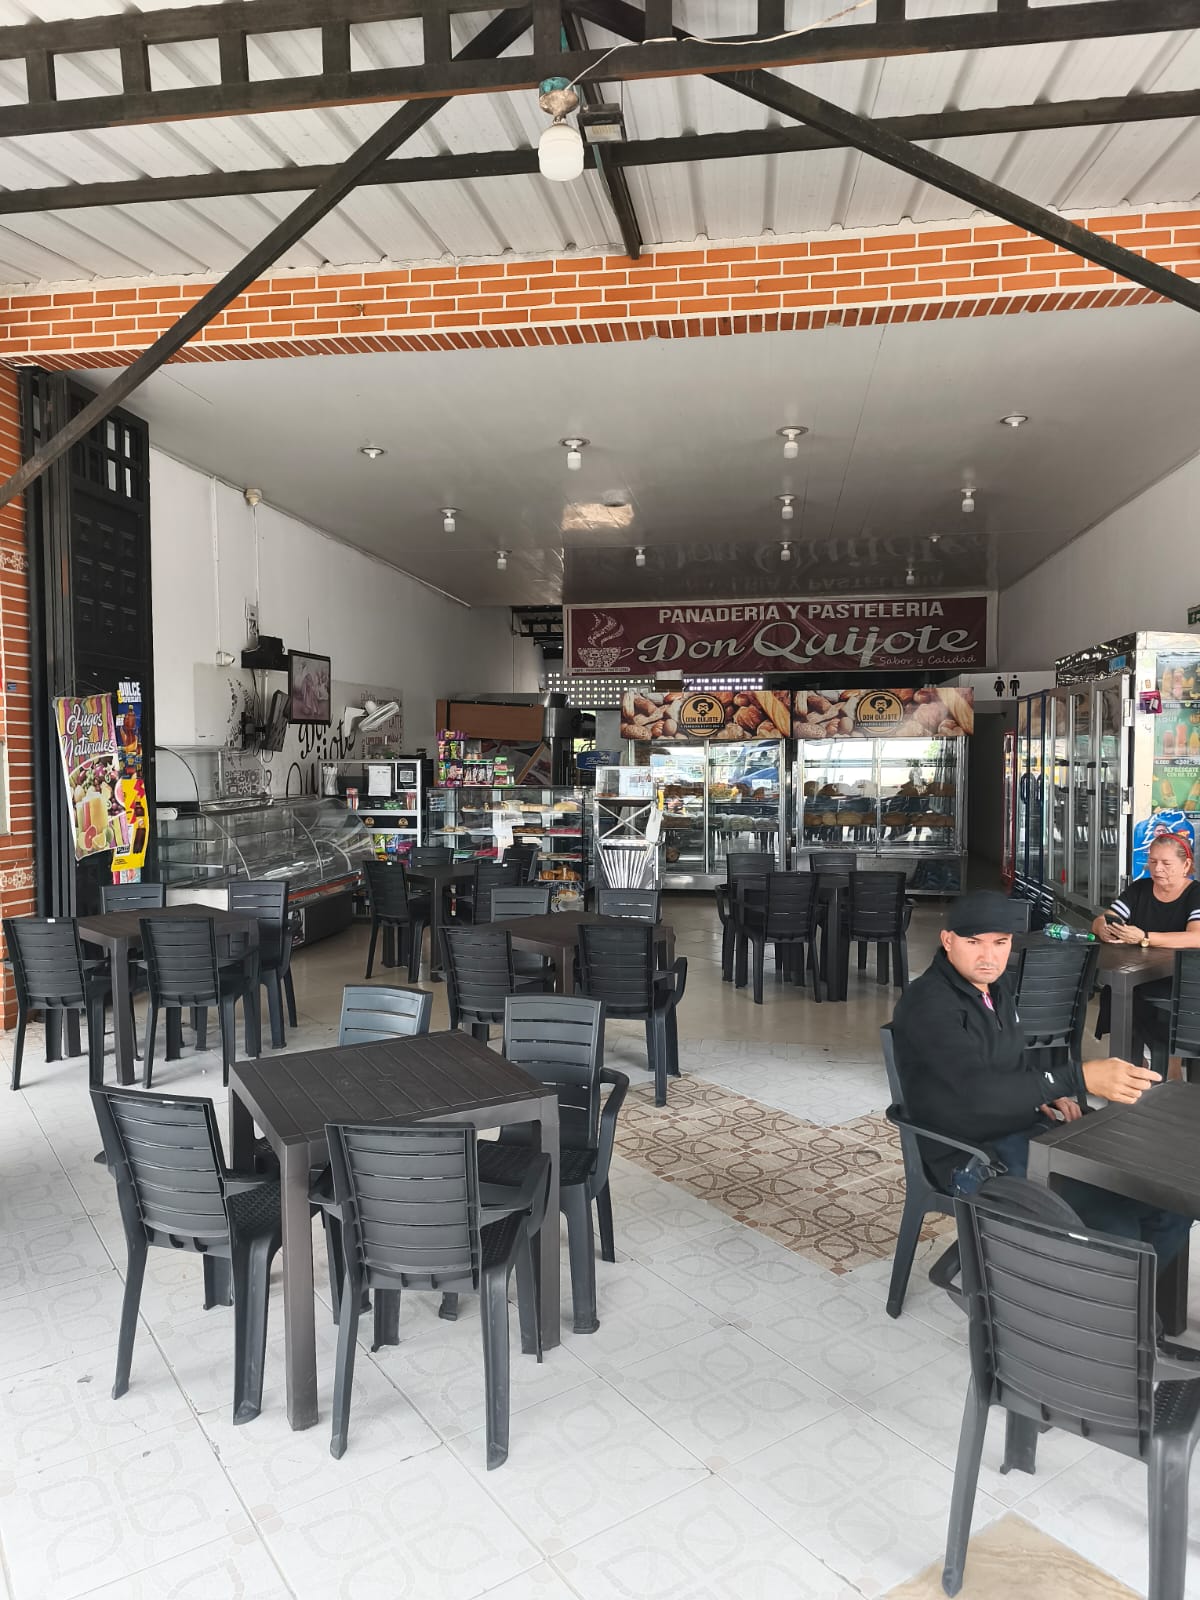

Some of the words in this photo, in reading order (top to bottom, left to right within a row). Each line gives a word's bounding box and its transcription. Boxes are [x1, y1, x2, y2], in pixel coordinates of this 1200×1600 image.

[658, 605, 780, 624] PANADERIA
[788, 604, 801, 620] Y
[808, 601, 944, 620] PASTELERIA
[636, 633, 745, 663] Don
[753, 621, 978, 668] Quijote
[879, 656, 912, 666] Sabor
[916, 658, 924, 667] y
[928, 654, 976, 665] Calidad
[118, 682, 142, 697] DULCE
[67, 704, 103, 735] Jugos
[61, 734, 116, 767] Naturales
